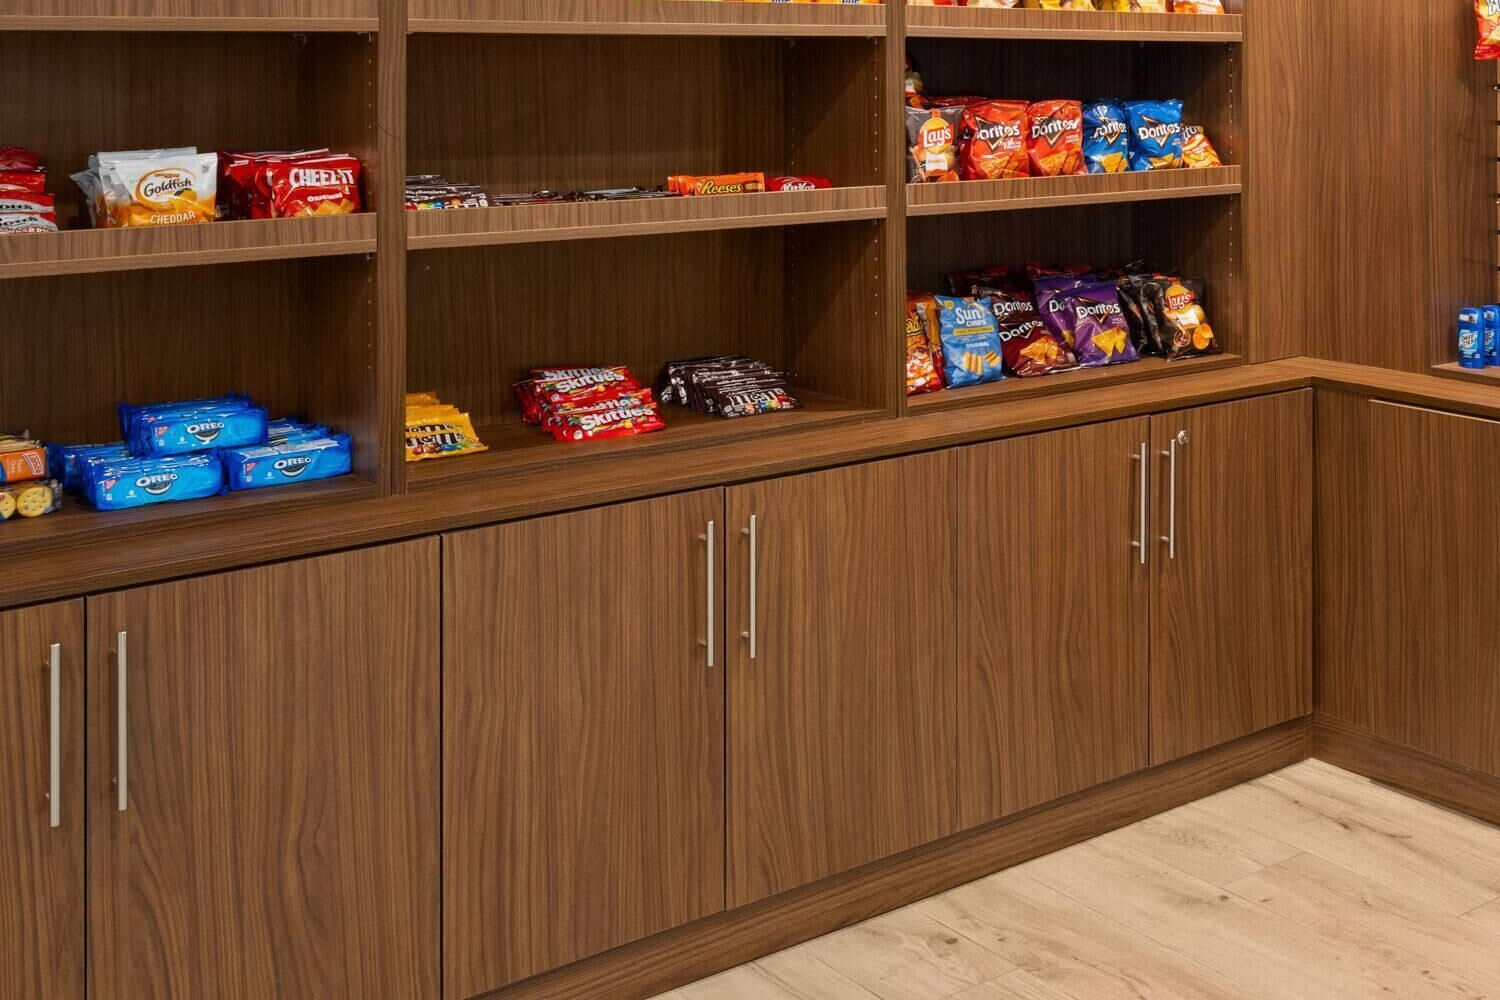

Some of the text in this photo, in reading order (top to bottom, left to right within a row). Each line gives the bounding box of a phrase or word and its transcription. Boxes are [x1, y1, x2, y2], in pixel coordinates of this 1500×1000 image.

[1032, 117, 1079, 138] Doritos
[1138, 122, 1180, 140] Doritos
[922, 126, 951, 148] Lay's
[143, 178, 193, 198] Goldfish
[701, 179, 742, 196] Reese's
[150, 210, 196, 225] CHEDDAR
[993, 301, 1034, 316] Doritos
[1168, 292, 1193, 310] Lay's
[955, 307, 984, 325] Sun
[1076, 302, 1121, 319] Doritos
[556, 371, 625, 393] Skittles
[186, 420, 225, 434] OREO
[581, 408, 654, 430] Skittles
[273, 457, 312, 470] OREO
[136, 474, 179, 487] OREO
